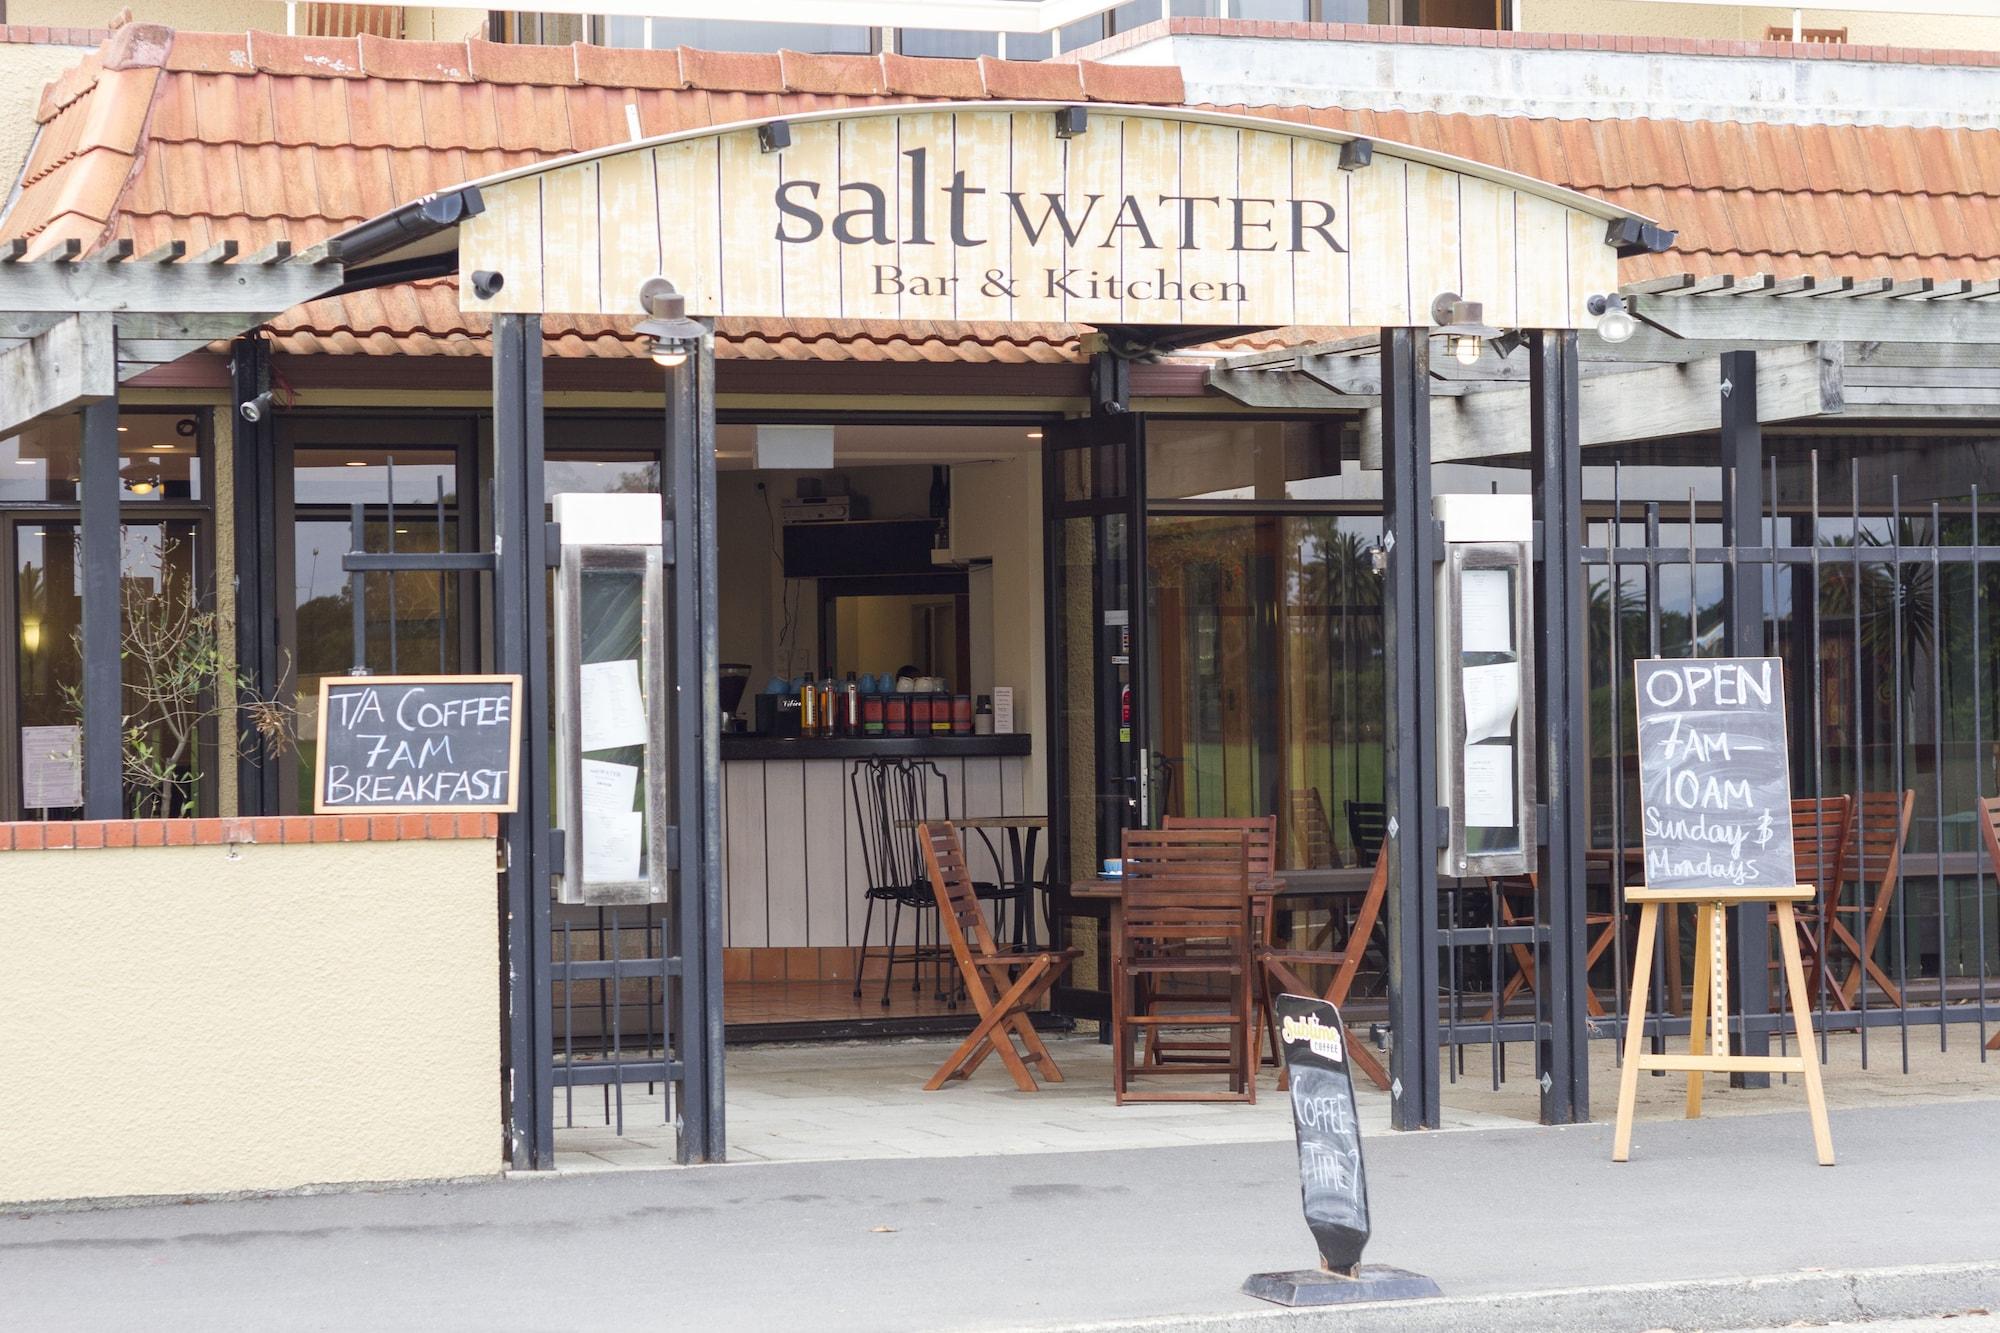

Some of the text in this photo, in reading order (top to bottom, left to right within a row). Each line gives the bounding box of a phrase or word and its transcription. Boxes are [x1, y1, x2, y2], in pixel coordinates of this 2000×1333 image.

[872, 264, 1249, 302] Bar & Kitchen
[1646, 661, 1772, 707] OPEN
[328, 687, 510, 732] T/A COFFEE
[325, 765, 509, 804] BREAKFAST
[1665, 767, 1754, 810] 10AM
[1645, 806, 1750, 859] Sunday
[1650, 847, 1760, 885] Mondays
[1283, 1014, 1341, 1044] Sublime
[1314, 1041, 1338, 1053] COFFEE
